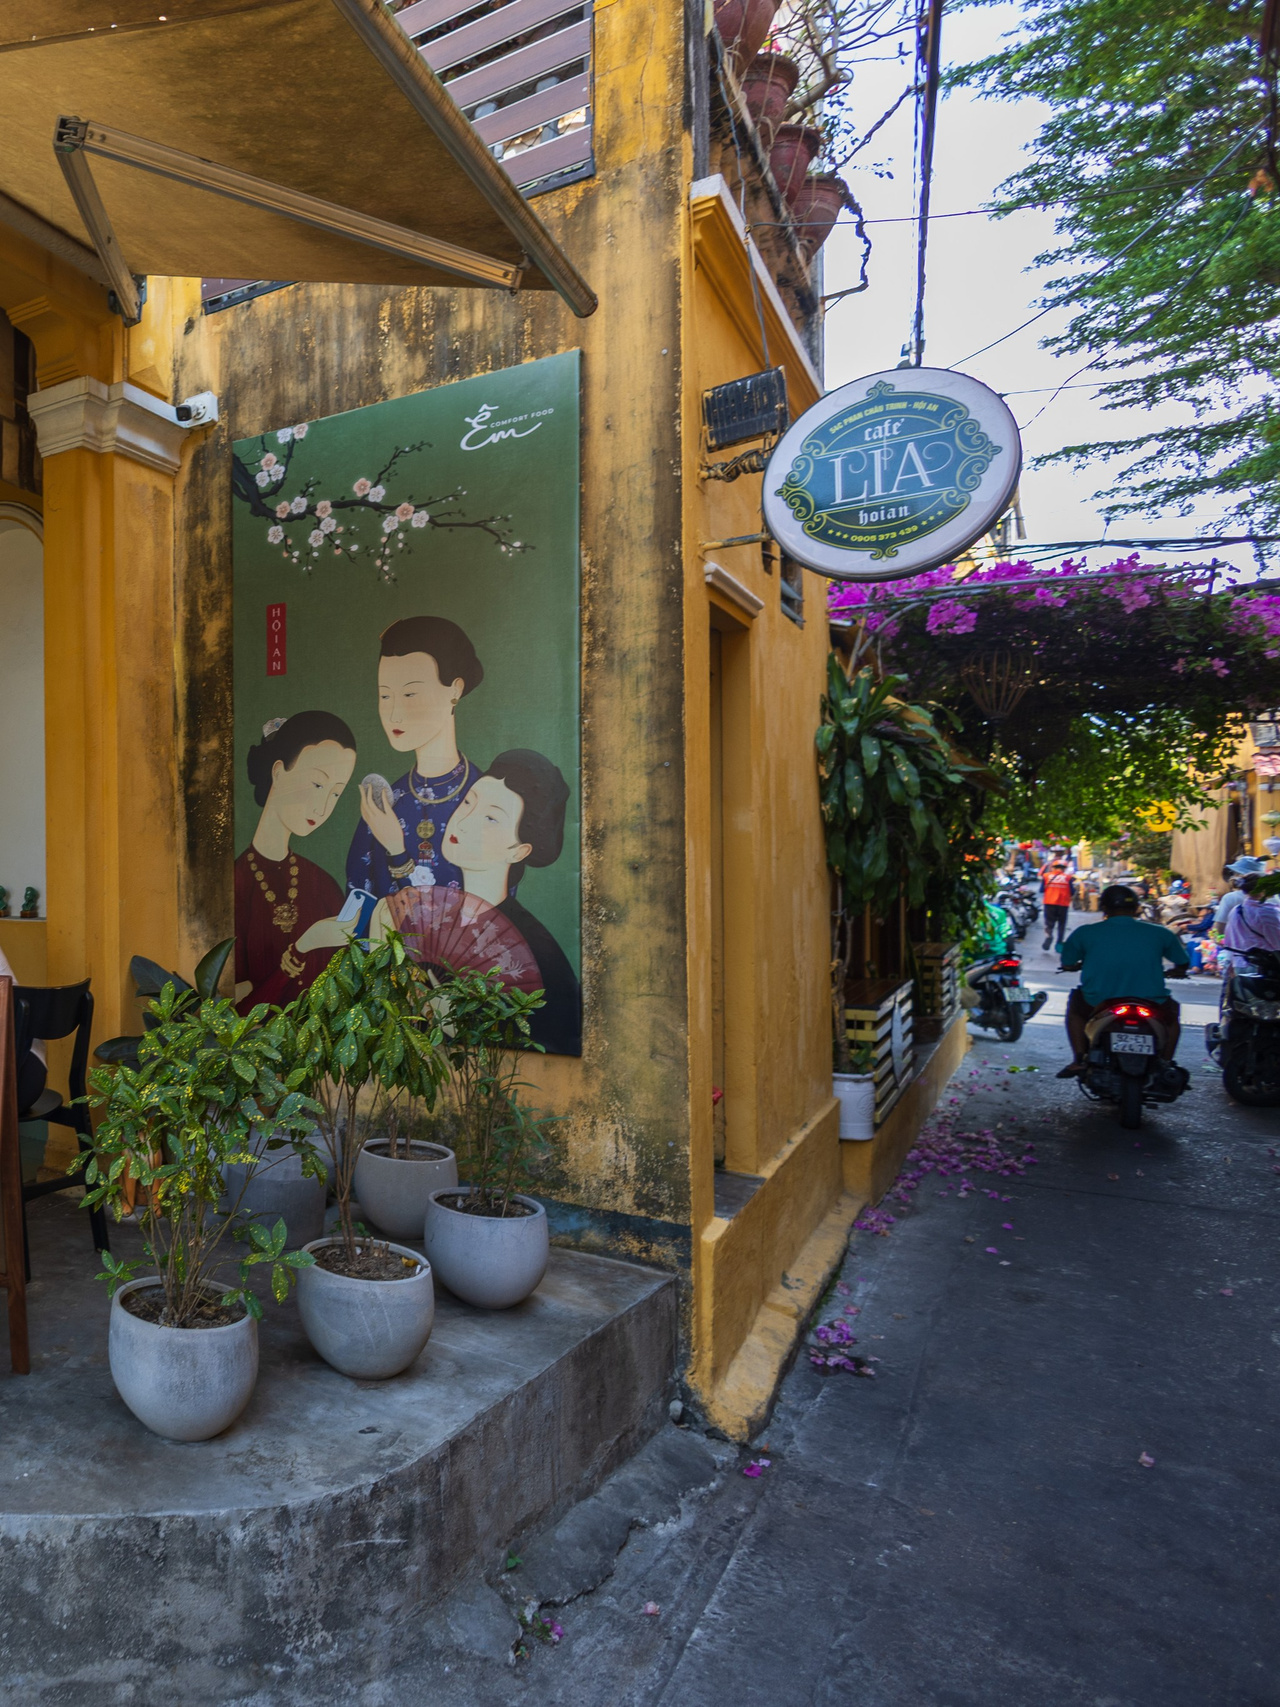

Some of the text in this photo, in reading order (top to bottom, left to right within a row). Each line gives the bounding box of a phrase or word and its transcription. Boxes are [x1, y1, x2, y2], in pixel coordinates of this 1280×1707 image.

[490, 407, 554, 429] COMFORT FOOD
[828, 441, 953, 505] LIA
[858, 504, 910, 526] hoian
[850, 533, 877, 542] 0905
[878, 531, 897, 541] 373
